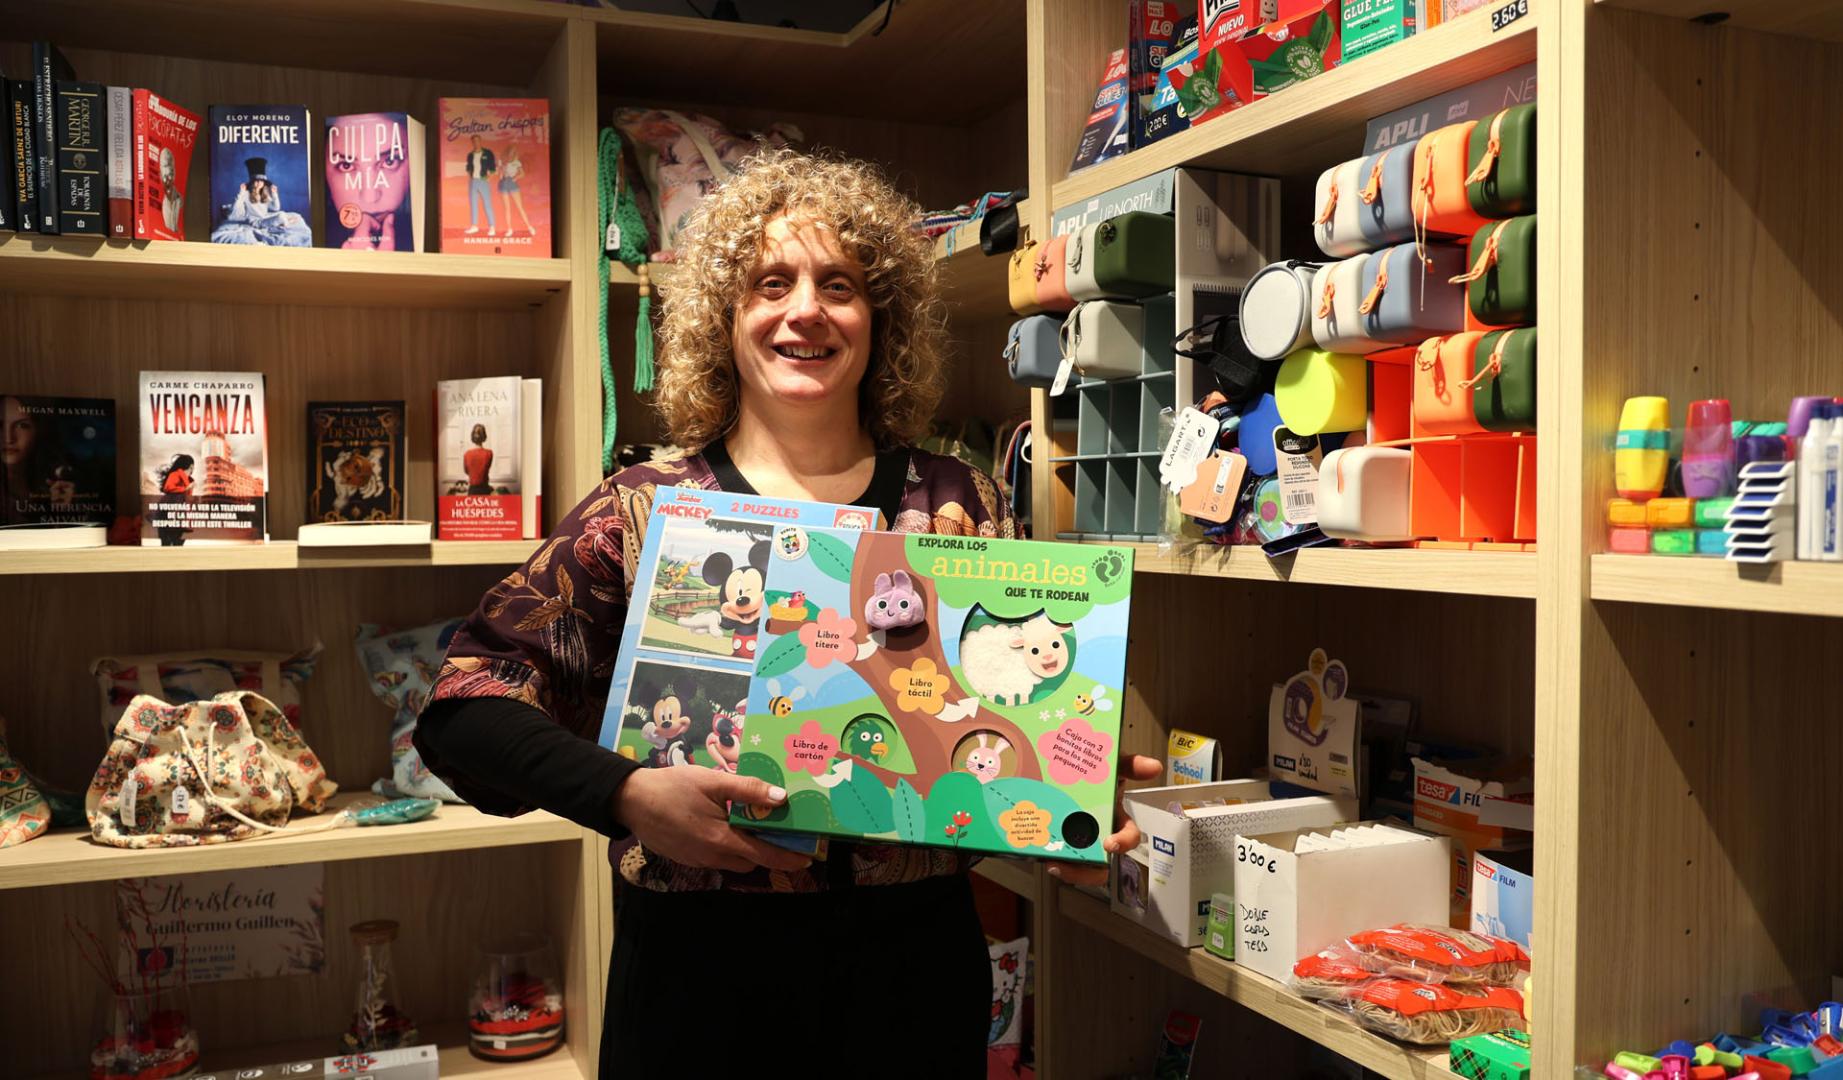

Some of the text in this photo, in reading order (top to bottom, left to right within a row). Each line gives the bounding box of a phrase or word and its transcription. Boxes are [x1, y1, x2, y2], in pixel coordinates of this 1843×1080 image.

[1218, 14, 1245, 37] NUEVO
[68, 98, 81, 146] MARTIN
[219, 125, 299, 143] DIFERENTE
[1374, 112, 1430, 149] APLI
[329, 122, 404, 164] CULPA
[345, 166, 389, 190] MÍA
[1057, 213, 1088, 237] APLI
[17, 406, 106, 416] MEGAN MAXWELL
[150, 393, 254, 434] VENGANZA
[458, 406, 500, 417] RIVERA
[464, 497, 490, 507] CASA
[210, 512, 237, 520] MANERA
[656, 503, 715, 519] MICKEY
[731, 502, 800, 519] 2 PUZZLES
[181, 520, 189, 528] DE
[917, 538, 988, 551] EXPLORA LOS
[931, 554, 1088, 587] animales
[1005, 587, 1089, 602] QUE TE RODEAN
[817, 630, 840, 640] Libro
[909, 677, 933, 688] Libro
[908, 688, 932, 698] táctil
[793, 739, 828, 751] Libro de
[1056, 733, 1102, 762] bonitos libros
[1065, 728, 1104, 752] Caja con 3
[794, 751, 823, 761] cartón
[1053, 744, 1070, 755] para
[1071, 750, 1081, 761] los
[1053, 754, 1088, 774] pequeños
[1173, 760, 1204, 780] School
[1420, 780, 1446, 798] tesa
[1463, 792, 1480, 807] FIL
[1154, 837, 1174, 854] MILAN
[1477, 862, 1491, 876] tesa
[1499, 875, 1516, 888] FILM
[146, 918, 232, 934] Guillermo
